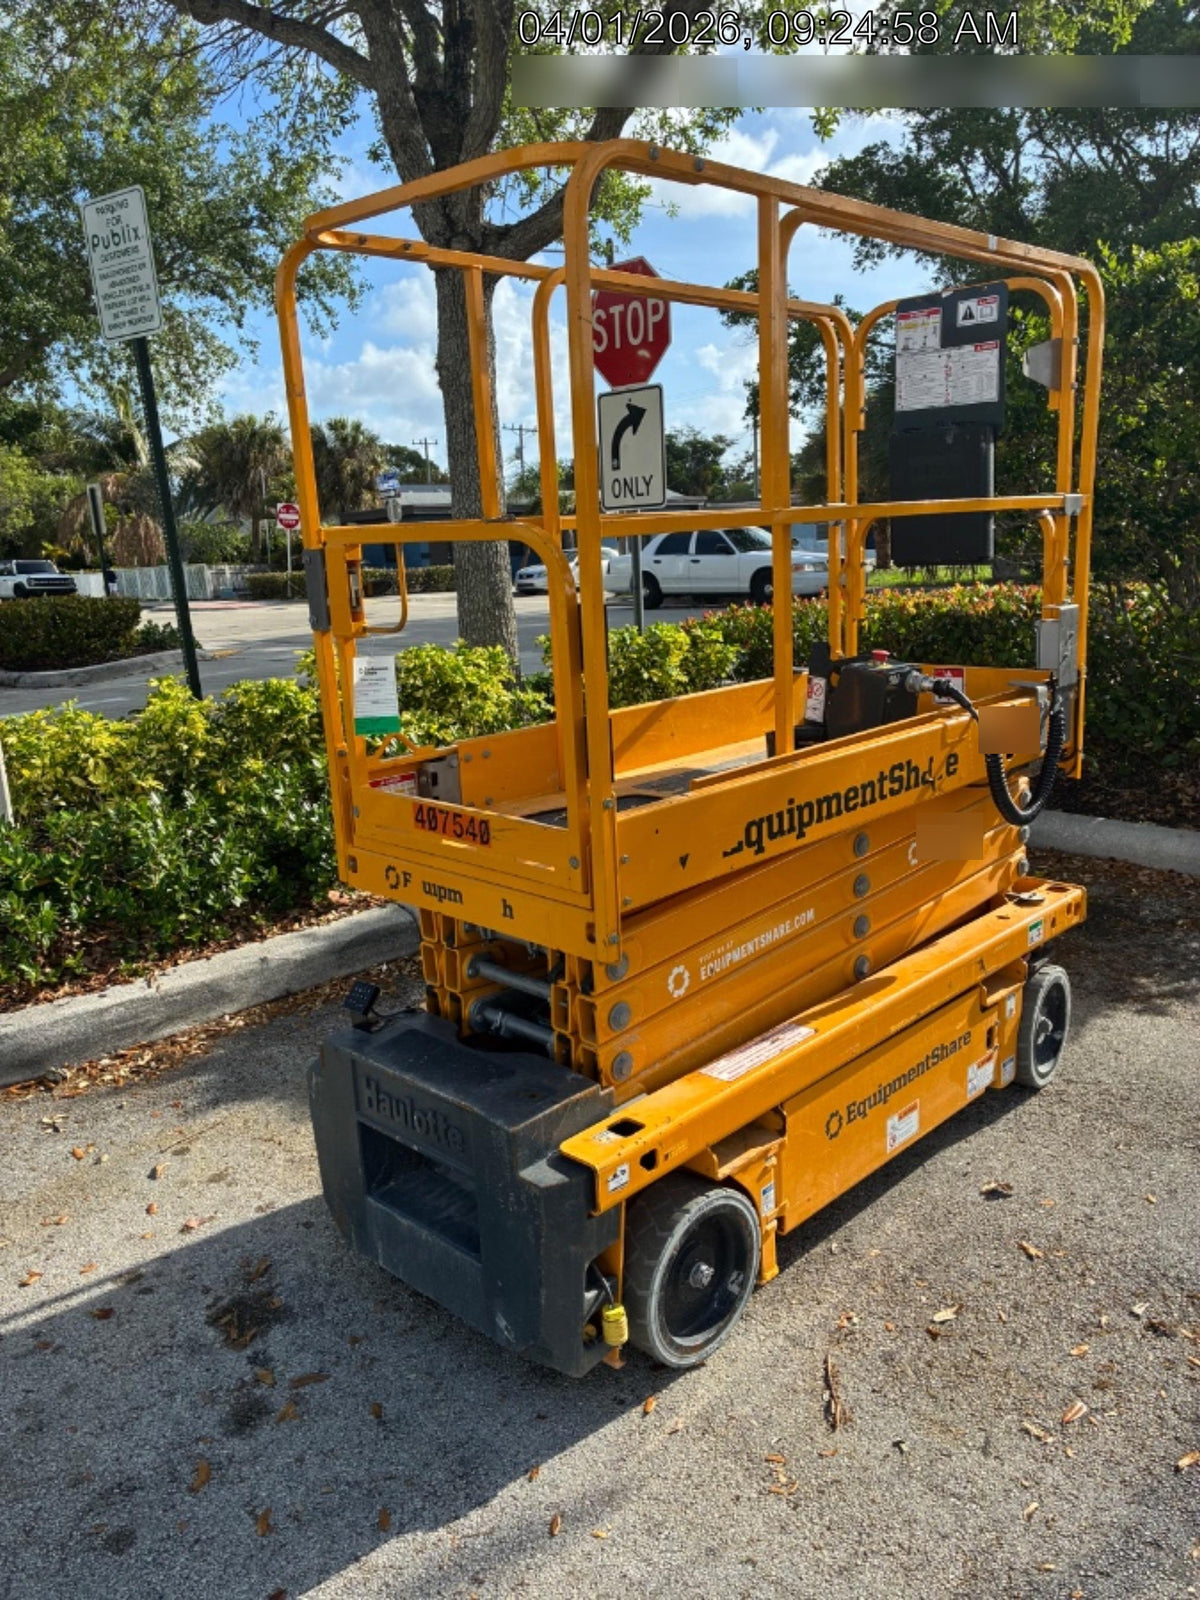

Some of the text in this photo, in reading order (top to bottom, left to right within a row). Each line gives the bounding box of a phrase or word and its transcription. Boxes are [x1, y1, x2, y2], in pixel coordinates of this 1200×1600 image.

[95, 198, 129, 215] PARKING
[105, 214, 123, 228] FOR
[91, 223, 141, 253] Publix
[592, 297, 665, 353] STOP
[611, 474, 654, 500] ONLY
[414, 803, 491, 846] 407540
[700, 908, 815, 981] EQUIPMENTSHARE.COM
[846, 1031, 972, 1125] EquipmentShare
[365, 1075, 466, 1153] Haulotte
